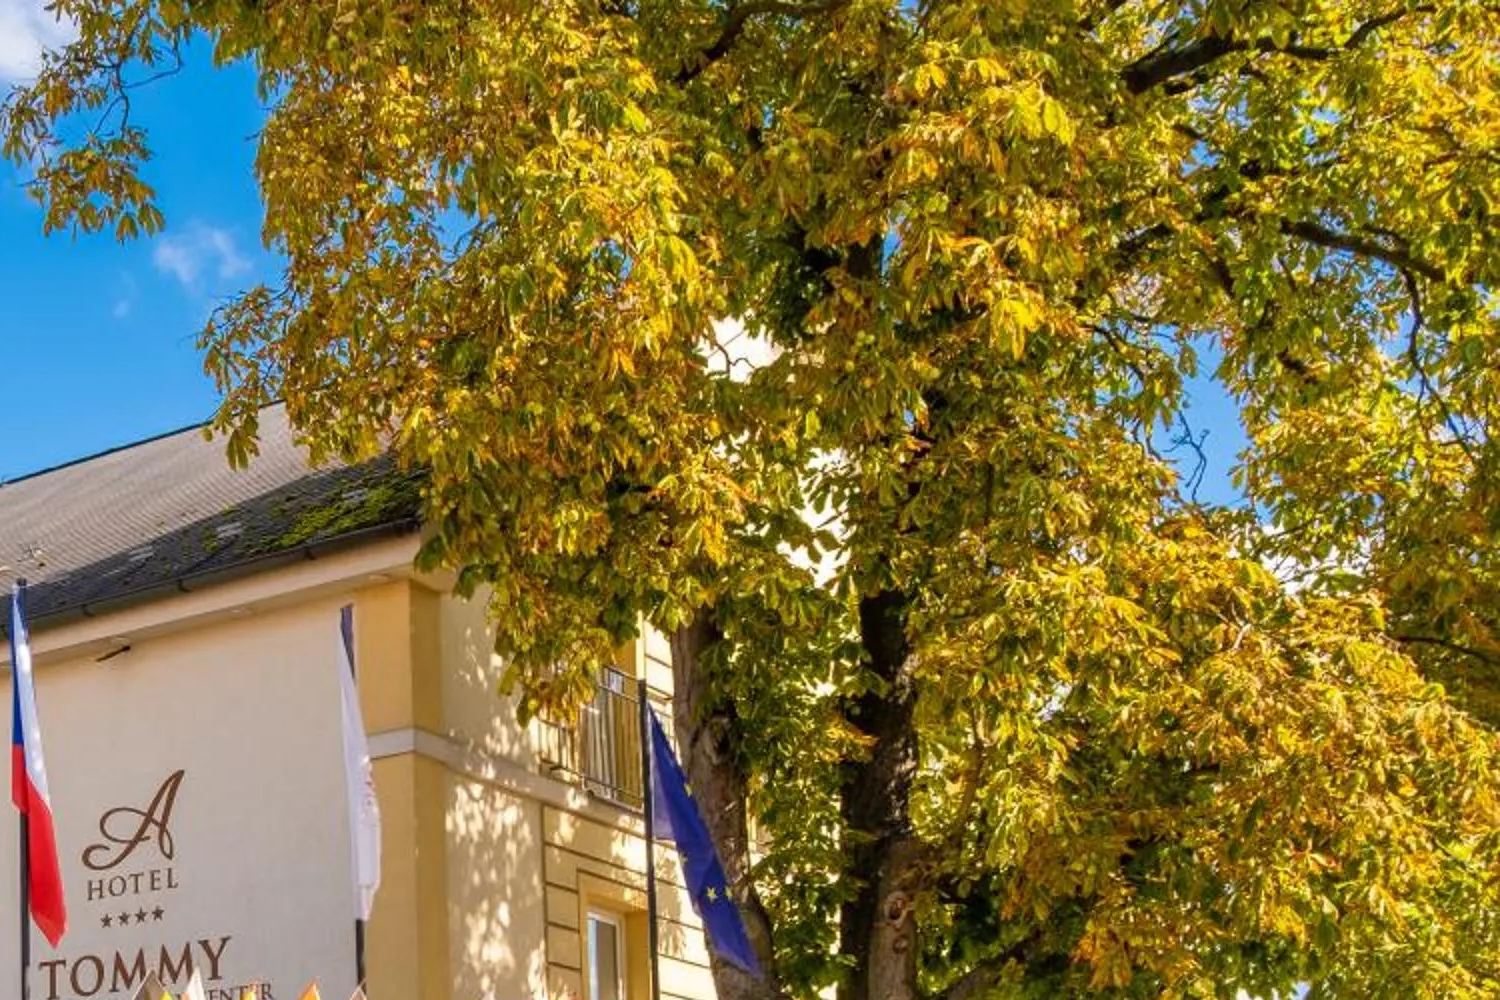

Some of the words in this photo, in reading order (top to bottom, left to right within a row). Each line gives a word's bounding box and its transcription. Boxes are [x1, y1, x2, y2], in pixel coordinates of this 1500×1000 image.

[81, 769, 185, 871] A
[87, 867, 179, 901] HOTEL
[38, 935, 232, 1000] TOMMY
